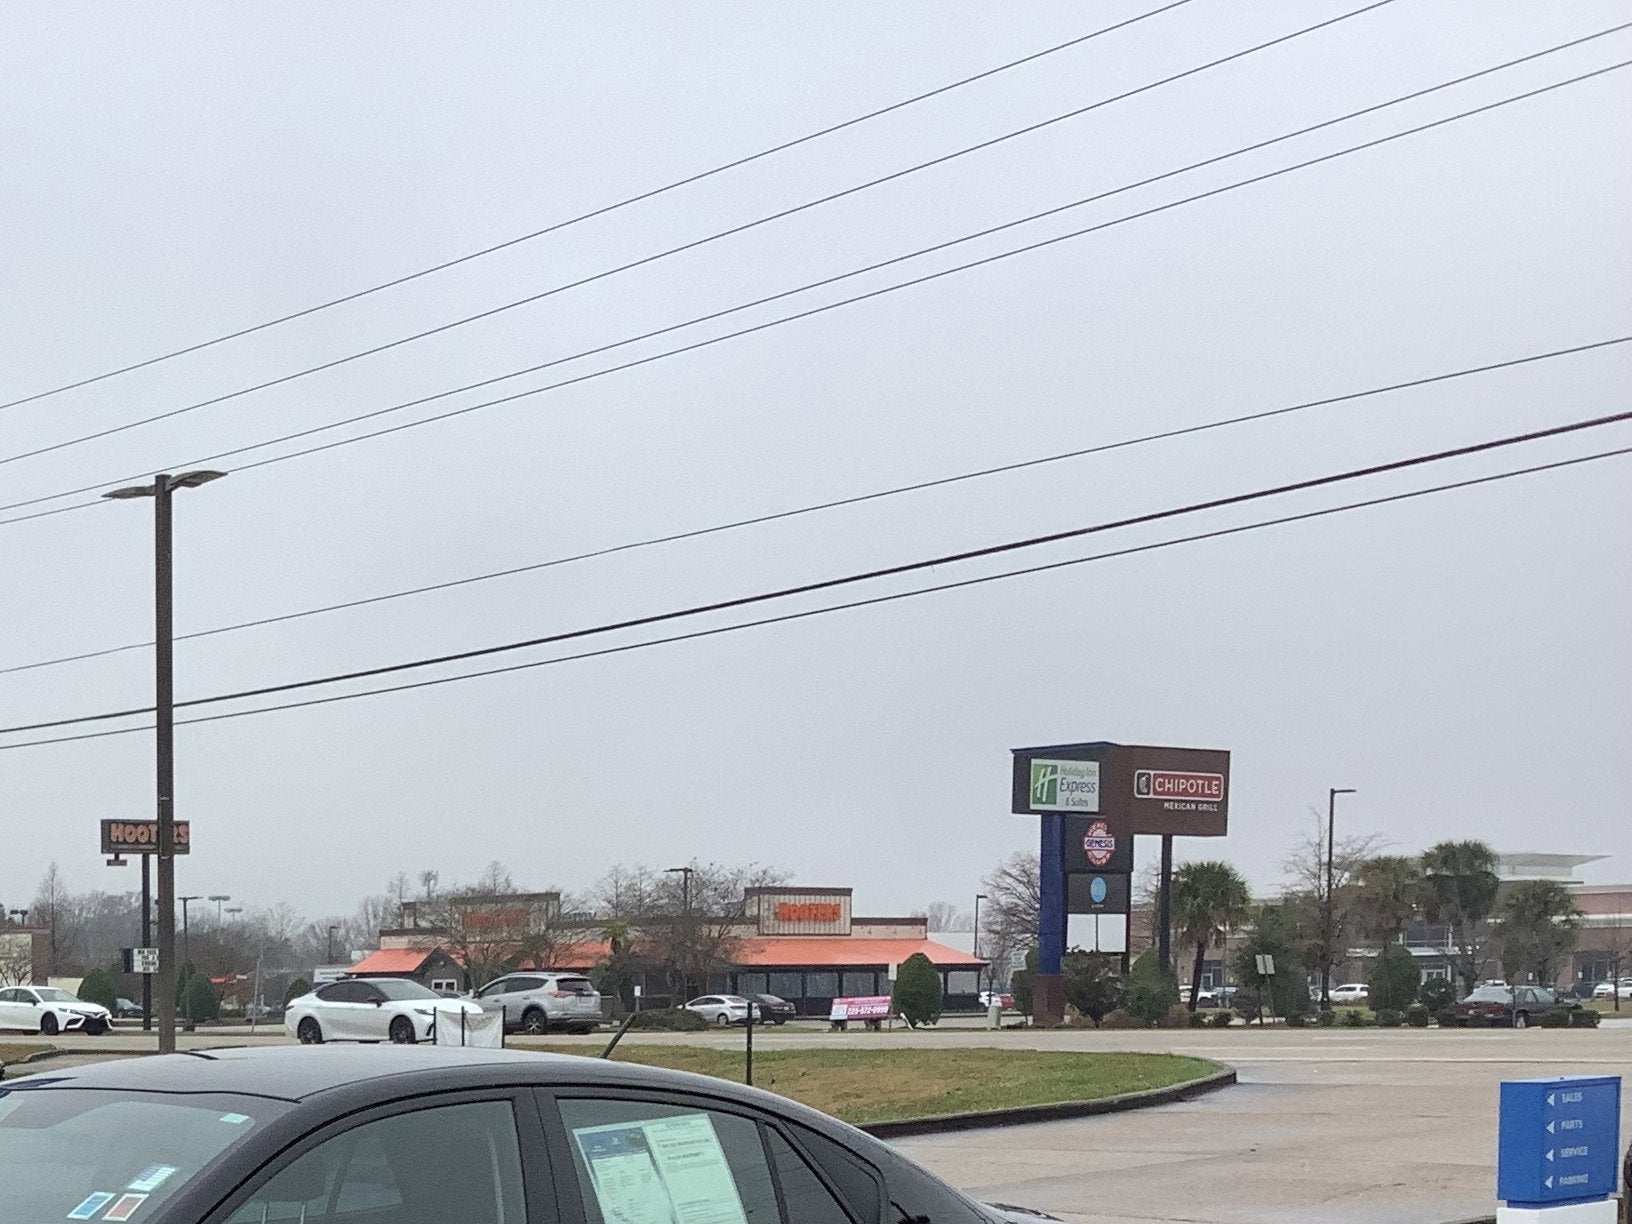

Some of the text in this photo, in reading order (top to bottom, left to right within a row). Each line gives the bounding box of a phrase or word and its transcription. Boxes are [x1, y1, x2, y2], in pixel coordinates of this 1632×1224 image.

[1060, 777, 1096, 795] Express
[1155, 778, 1220, 795] CHIPOTLE
[110, 823, 189, 844] HOOTS
